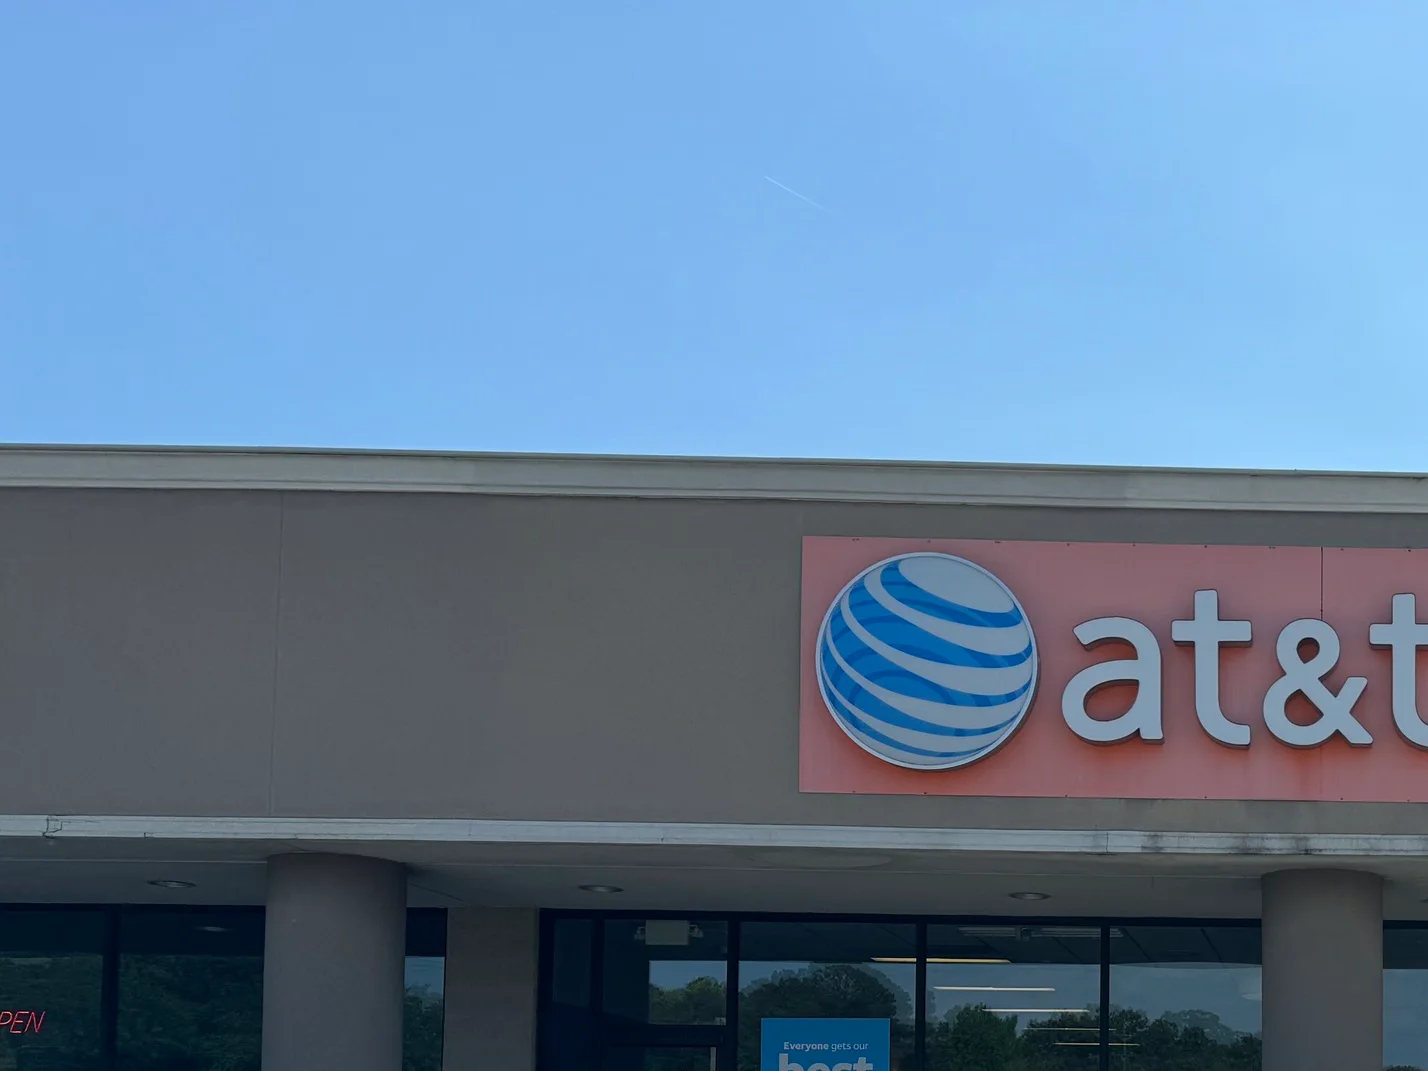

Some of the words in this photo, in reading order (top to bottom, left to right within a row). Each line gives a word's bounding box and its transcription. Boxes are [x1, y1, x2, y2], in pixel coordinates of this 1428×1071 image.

[0, 1011, 46, 1034] PEN
[783, 1041, 830, 1052] Everyone
[831, 1042, 852, 1052] gets
[852, 1043, 869, 1051] our
